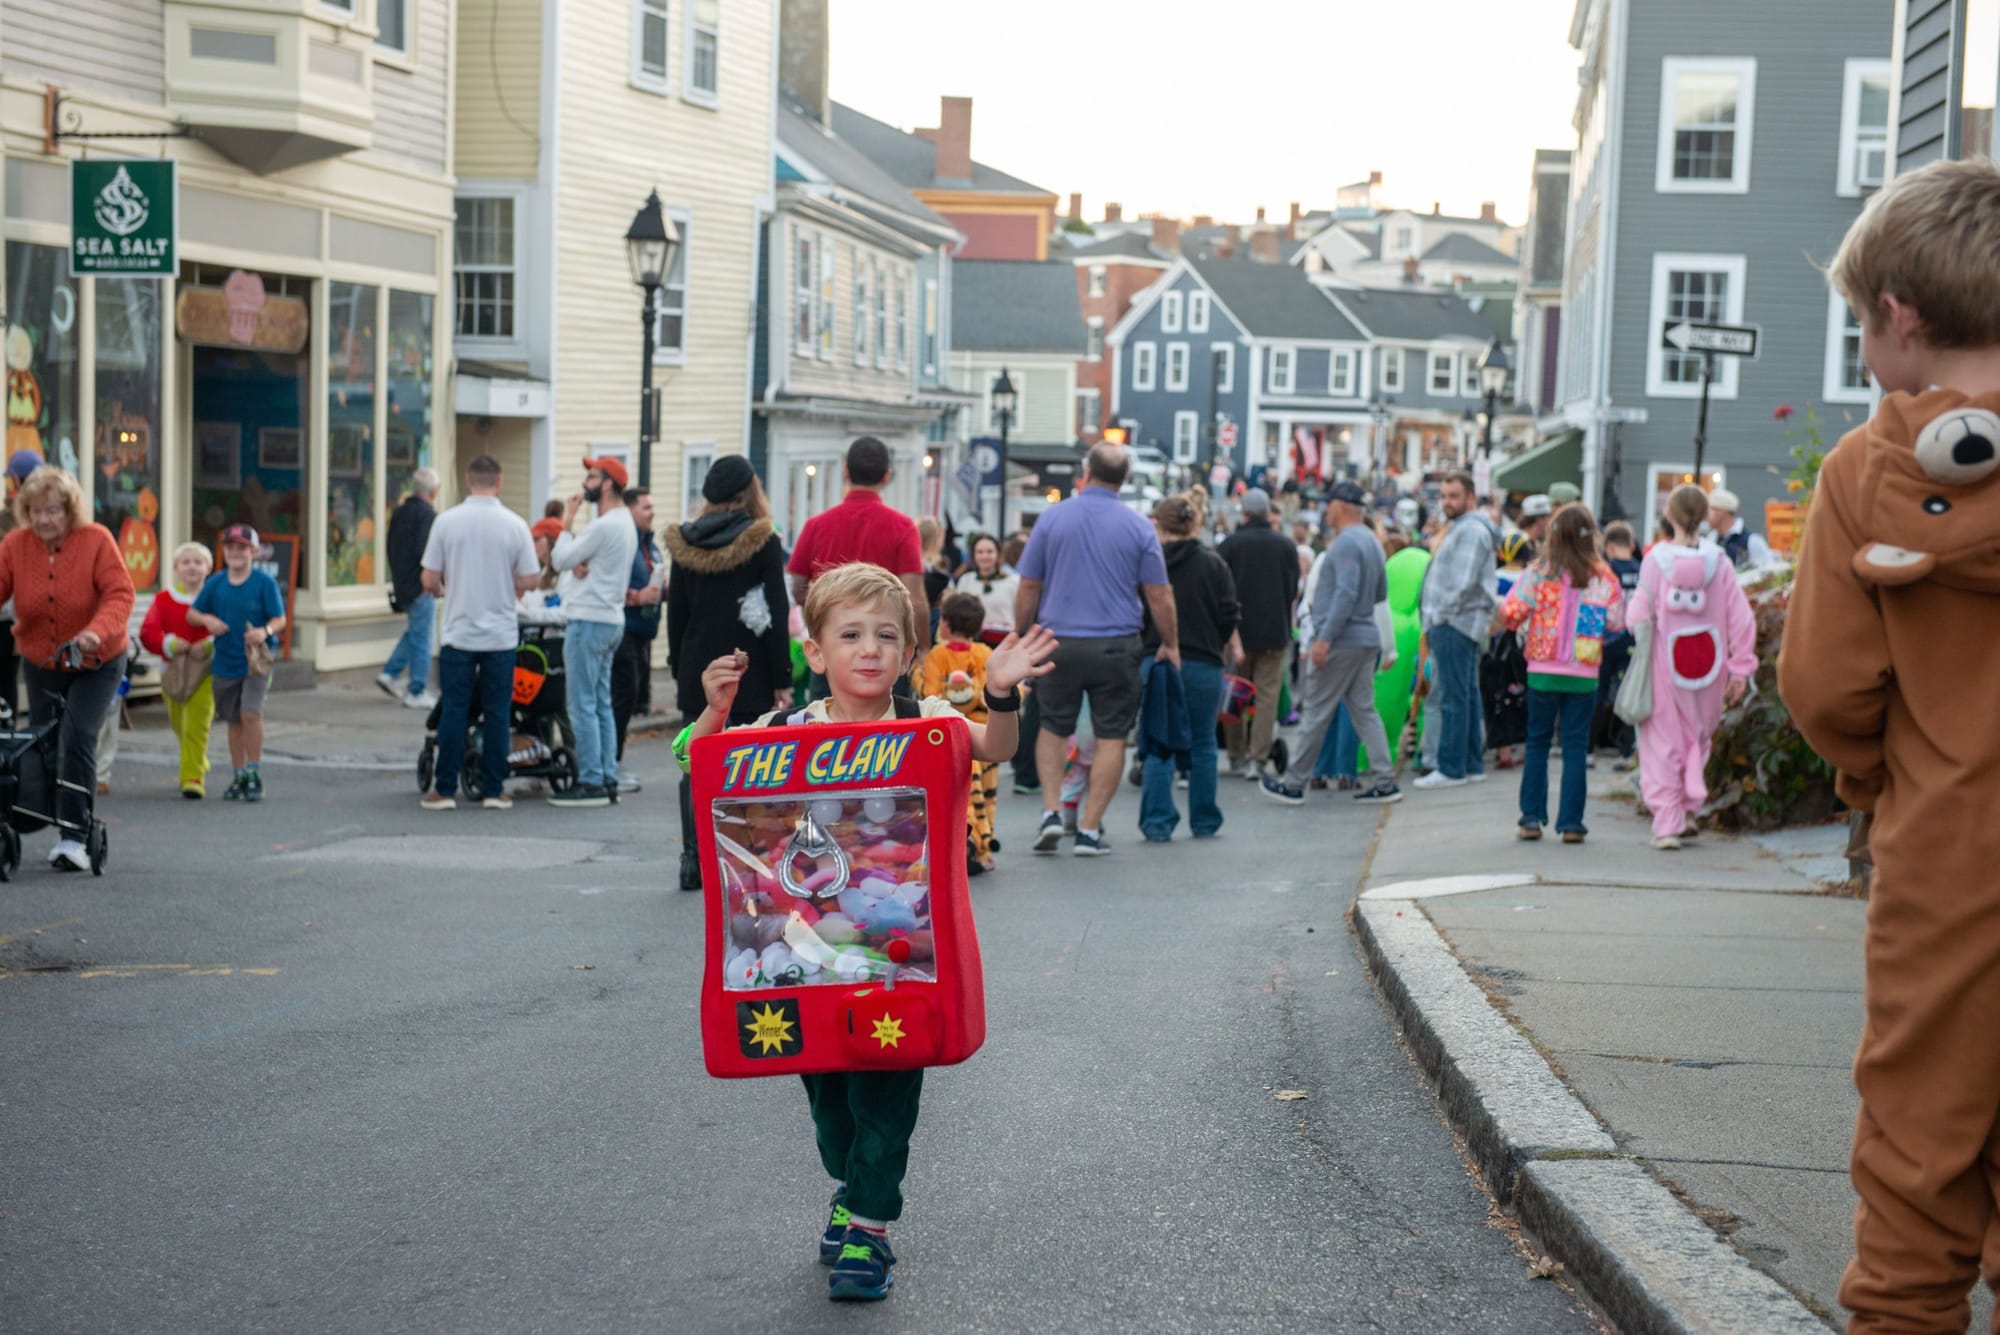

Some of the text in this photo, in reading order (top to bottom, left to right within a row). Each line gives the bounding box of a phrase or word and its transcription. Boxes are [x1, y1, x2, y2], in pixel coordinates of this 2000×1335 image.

[76, 237, 169, 256] SEA SALT
[724, 732, 915, 790] THE CLAW
